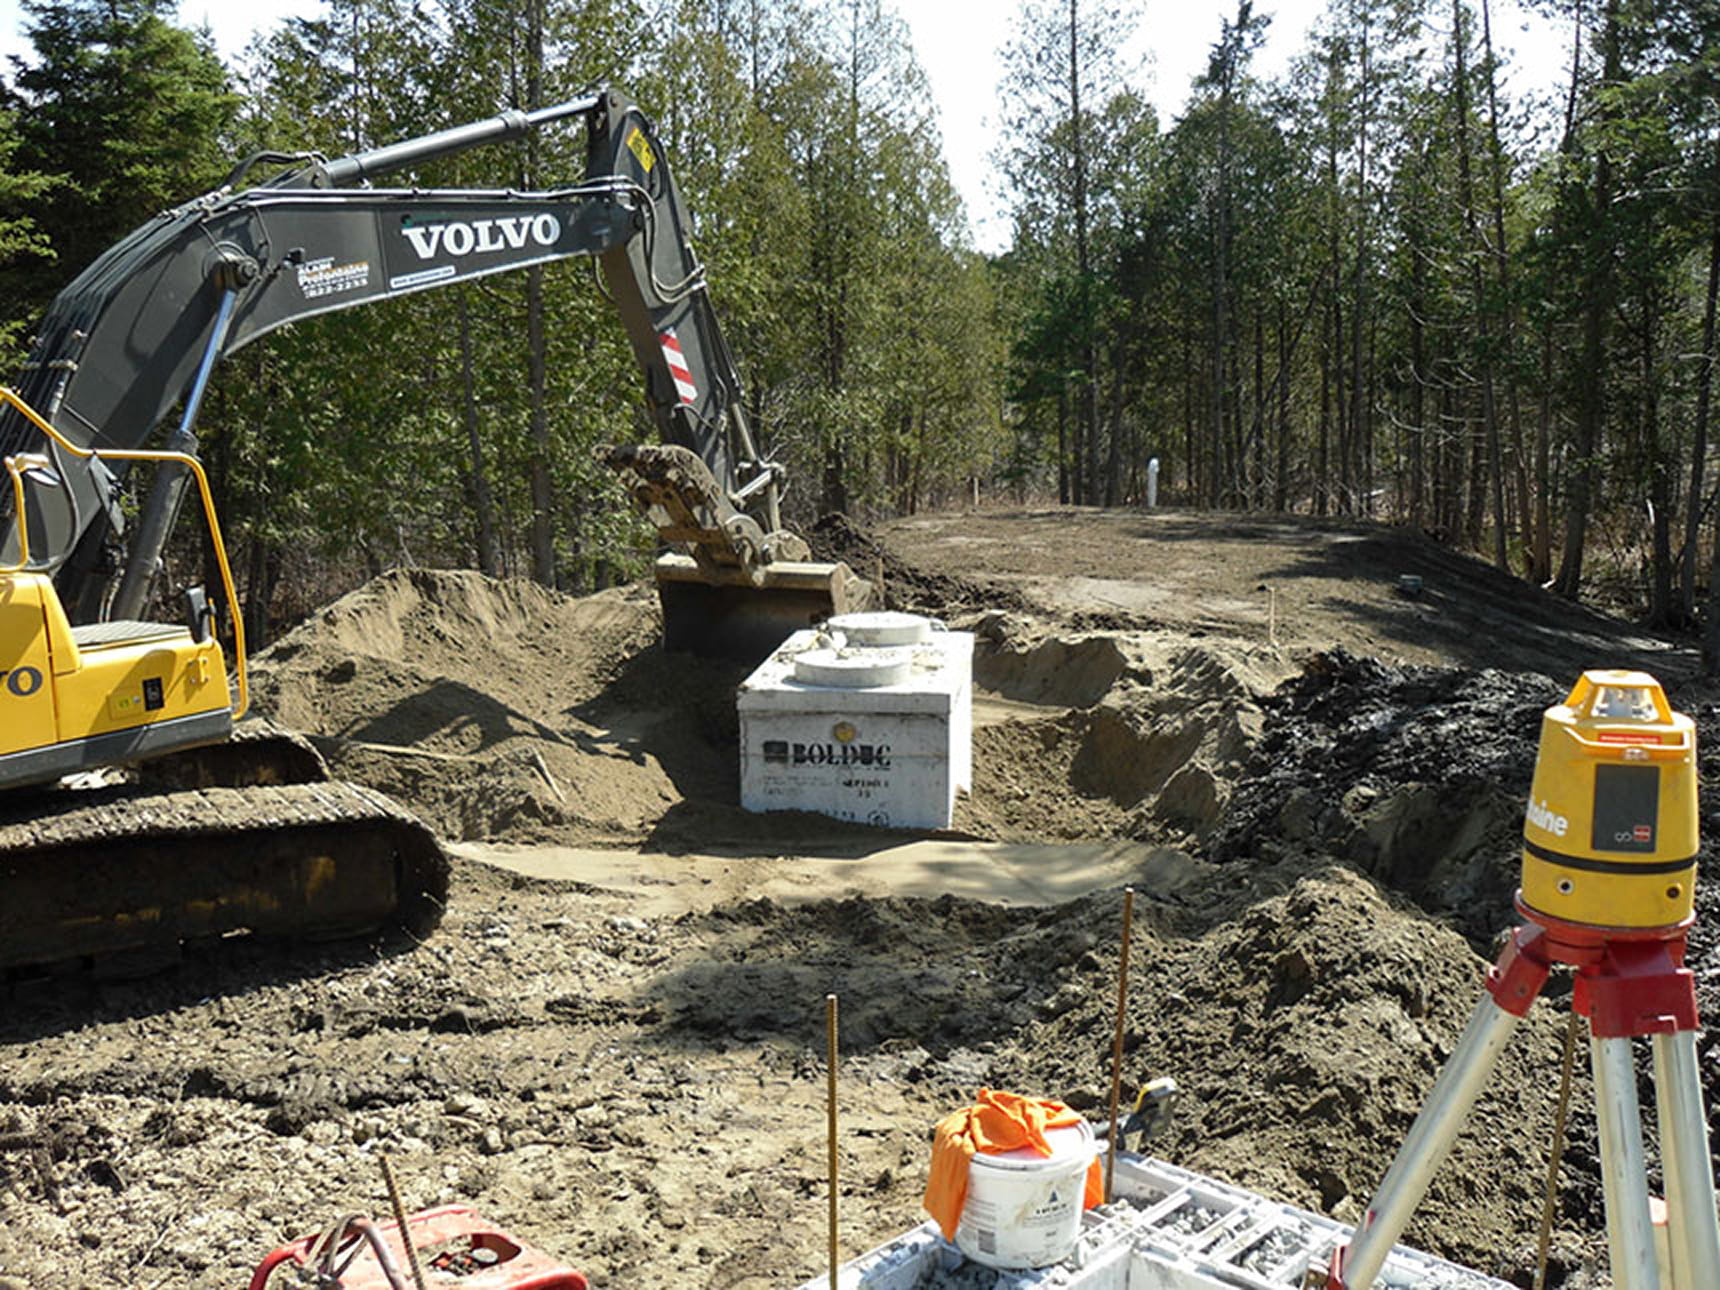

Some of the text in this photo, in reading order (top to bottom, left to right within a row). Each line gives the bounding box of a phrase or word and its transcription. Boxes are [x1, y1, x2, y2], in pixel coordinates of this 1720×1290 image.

[402, 213, 560, 259] VOLVO
[0, 666, 43, 696] O
[792, 743, 891, 766] BOLDUC
